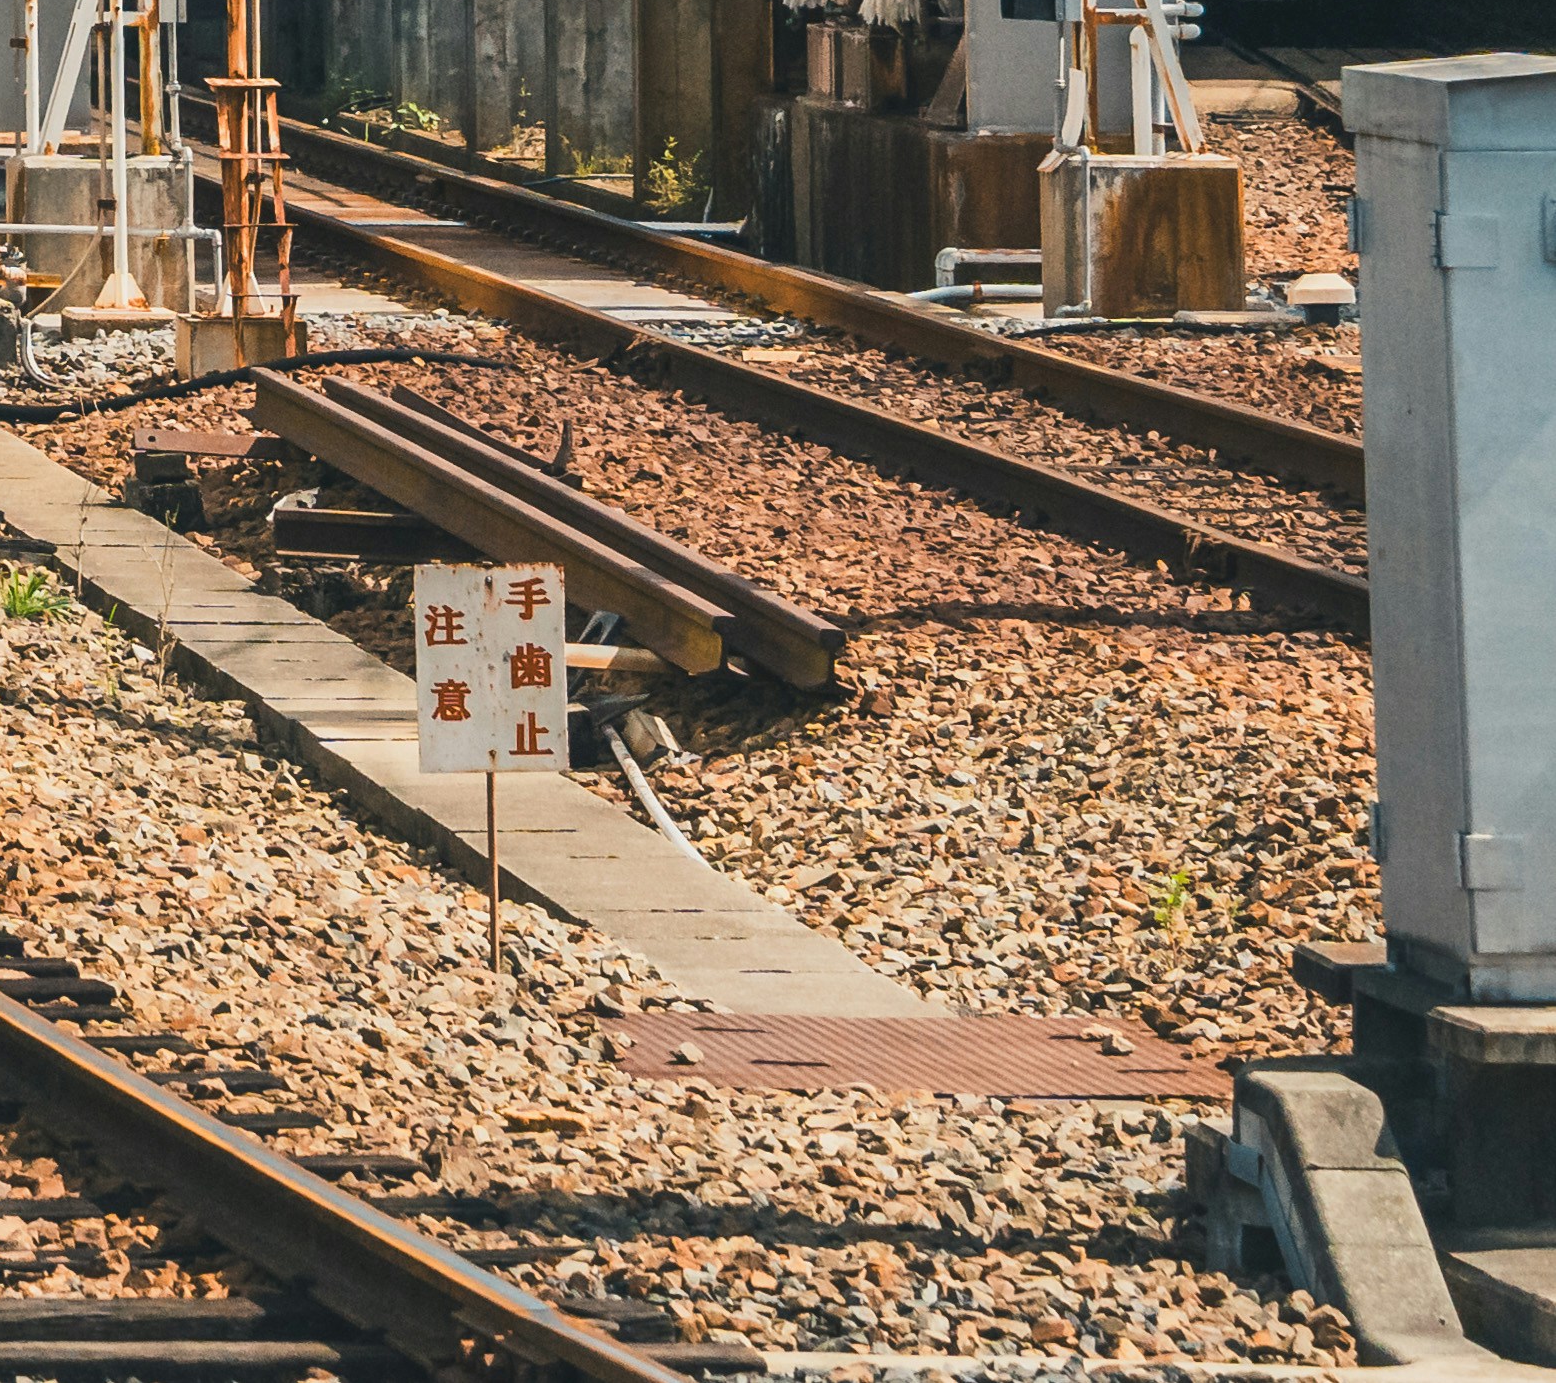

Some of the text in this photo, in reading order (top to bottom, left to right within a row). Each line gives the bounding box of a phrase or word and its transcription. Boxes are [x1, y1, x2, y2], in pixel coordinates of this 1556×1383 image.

[424, 604, 472, 722] 注意
[505, 577, 554, 757] 手歯止
